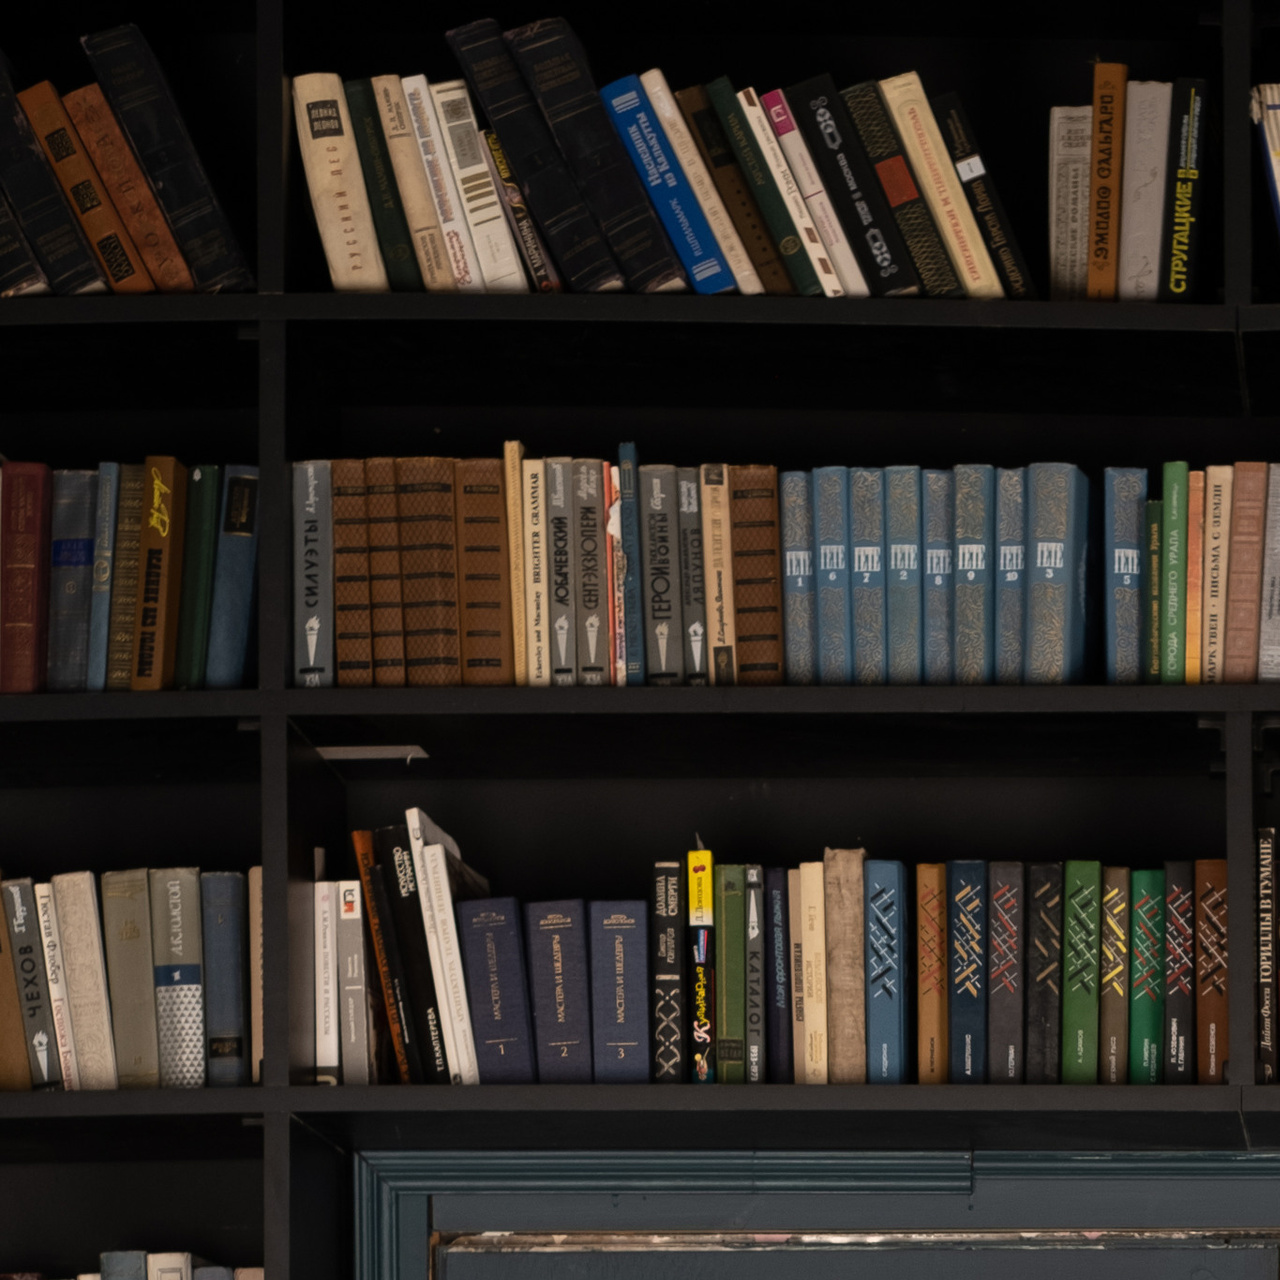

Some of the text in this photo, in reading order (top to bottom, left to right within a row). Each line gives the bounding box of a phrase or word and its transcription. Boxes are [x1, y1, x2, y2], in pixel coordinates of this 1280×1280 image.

[627, 122, 663, 187] Наследник
[636, 111, 678, 188] из Калькутты
[728, 111, 752, 146] КАРИМ
[1094, 94, 1115, 261] ЭМИЛИО САЛЬГАРИ
[518, 218, 544, 268] МАРИНИНА
[1169, 181, 1196, 294] СТРУГАЦКИЕ
[303, 519, 319, 608] СИЛУЭТЫ
[530, 472, 543, 643] and BRIGHTER GRAMMAR
[551, 515, 570, 608] ЛОБАЧЕВСКИЙ
[581, 505, 600, 610] СЕНТ-ЭКЗЮПЕРИ
[656, 512, 671, 565] ВОЙНЫ
[1208, 484, 1223, 647] ТВЕН ПИСЬМА С ЗЕМЛИ
[648, 564, 672, 621] ГЕРОИ
[688, 528, 705, 605] ЛЯПУНОВ
[797, 578, 804, 587] 1
[829, 571, 837, 581] 6
[863, 573, 871, 583] 7
[899, 571, 908, 580] 2
[935, 576, 943, 585] 8
[966, 571, 975, 581] 9
[1005, 571, 1018, 582] 10
[1045, 569, 1053, 579] 3
[1123, 575, 1131, 585] 5
[137, 548, 163, 678] ВСАДНИК БЕЗ ГОЛОВЫ
[1167, 529, 1180, 676] ГОРОДА СРЕДНЕГО УРАЛА
[393, 847, 409, 897] ИСКУССТВО
[402, 851, 417, 892] ИСПАНИИ
[655, 875, 666, 917] ДОЛИНА
[666, 875, 678, 917] СМЕРТИ
[39, 894, 71, 1048] Гюстав Флобер Госпожа
[774, 927, 786, 1008] Моя фронтовая
[1258, 837, 1272, 1052] Дайан Фосси ГОРИЛЛЫ В ТУМАНЕ
[19, 945, 42, 1018] ЧЕХОВ
[693, 966, 711, 1043] Кулинарная
[748, 950, 760, 1036] КАТАЛОГ
[498, 1044, 505, 1055] 1
[560, 1046, 569, 1057] 2
[617, 1048, 626, 1059] 3
